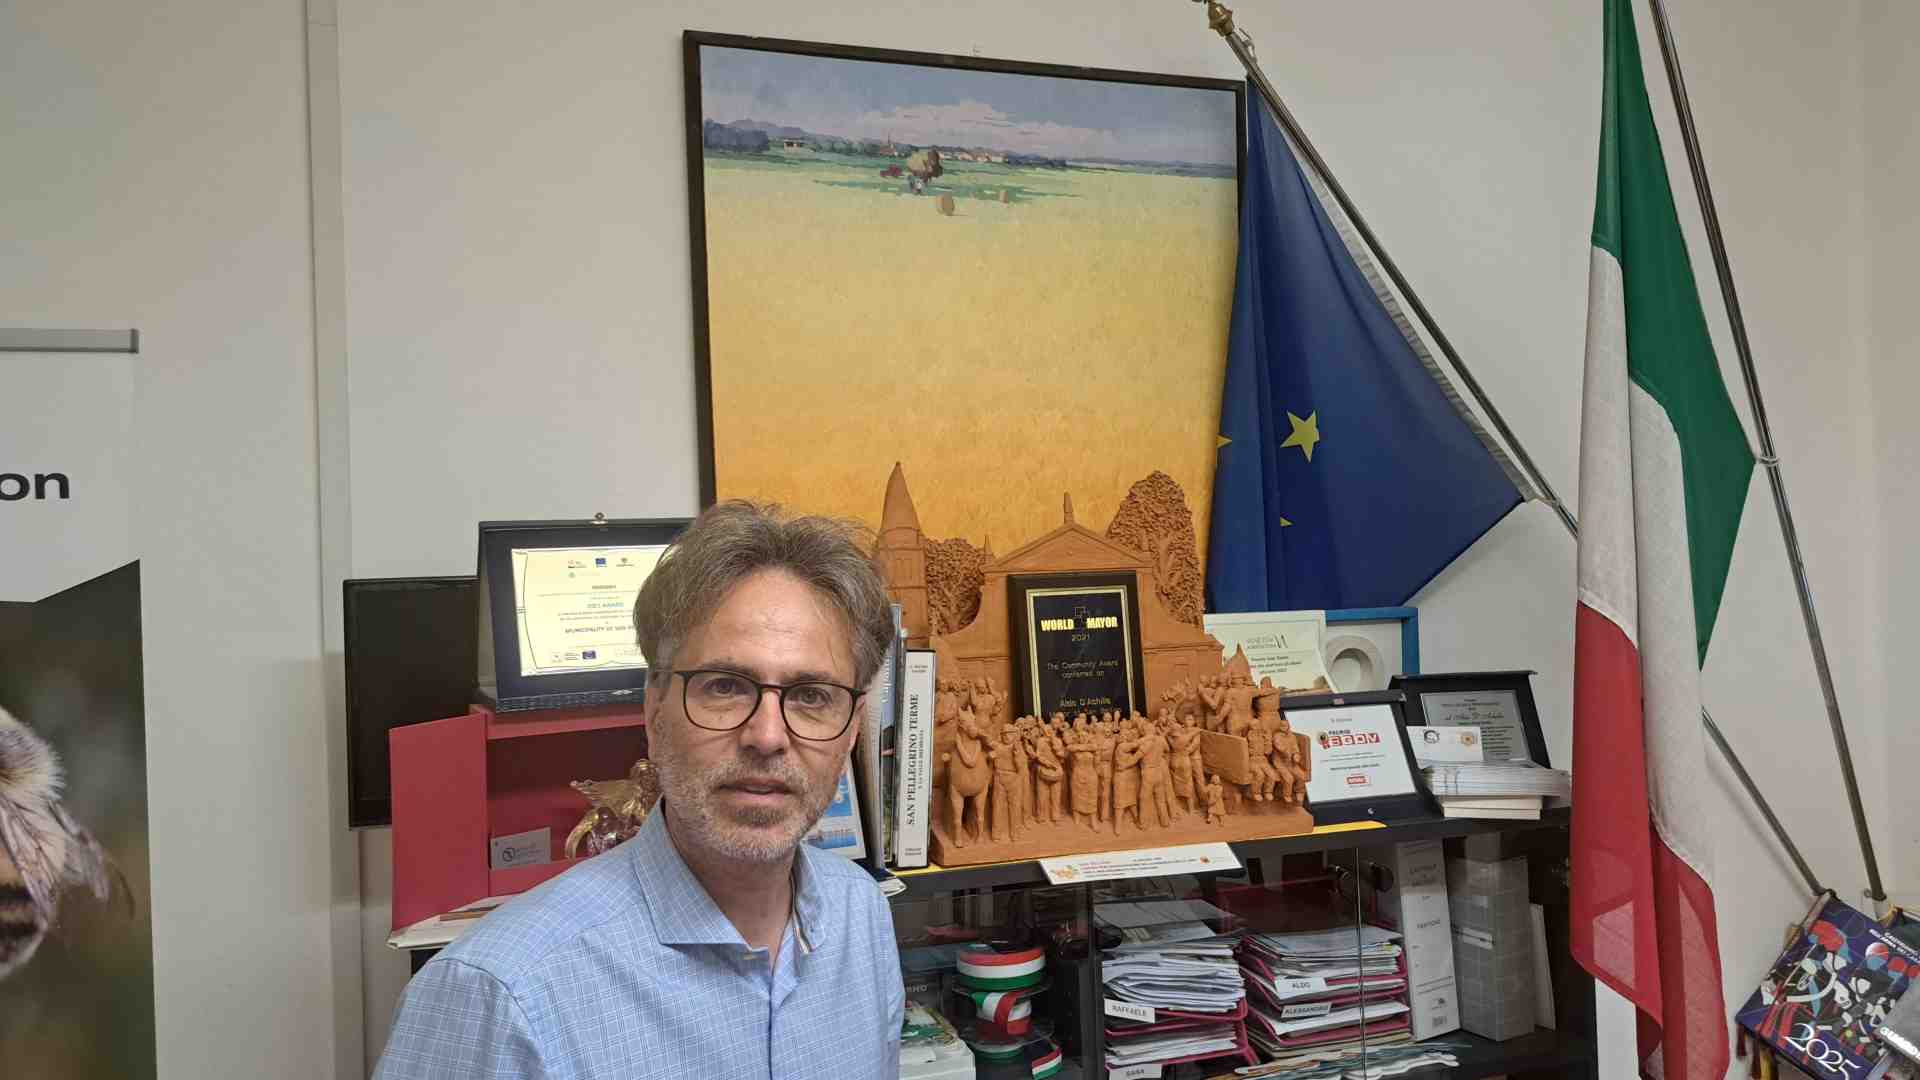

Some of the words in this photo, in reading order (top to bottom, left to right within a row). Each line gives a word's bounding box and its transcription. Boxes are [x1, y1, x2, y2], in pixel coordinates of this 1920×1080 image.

[1041, 619, 1074, 631] WORLD
[1086, 616, 1118, 629] MAYOR
[1071, 634, 1089, 642] 2021
[909, 694, 919, 730] TERME
[907, 734, 918, 800] PELLEGRINO
[906, 804, 915, 825] SAN
[1112, 1005, 1147, 1017] RAFFAELE
[1783, 1022, 1861, 1080] 2025
